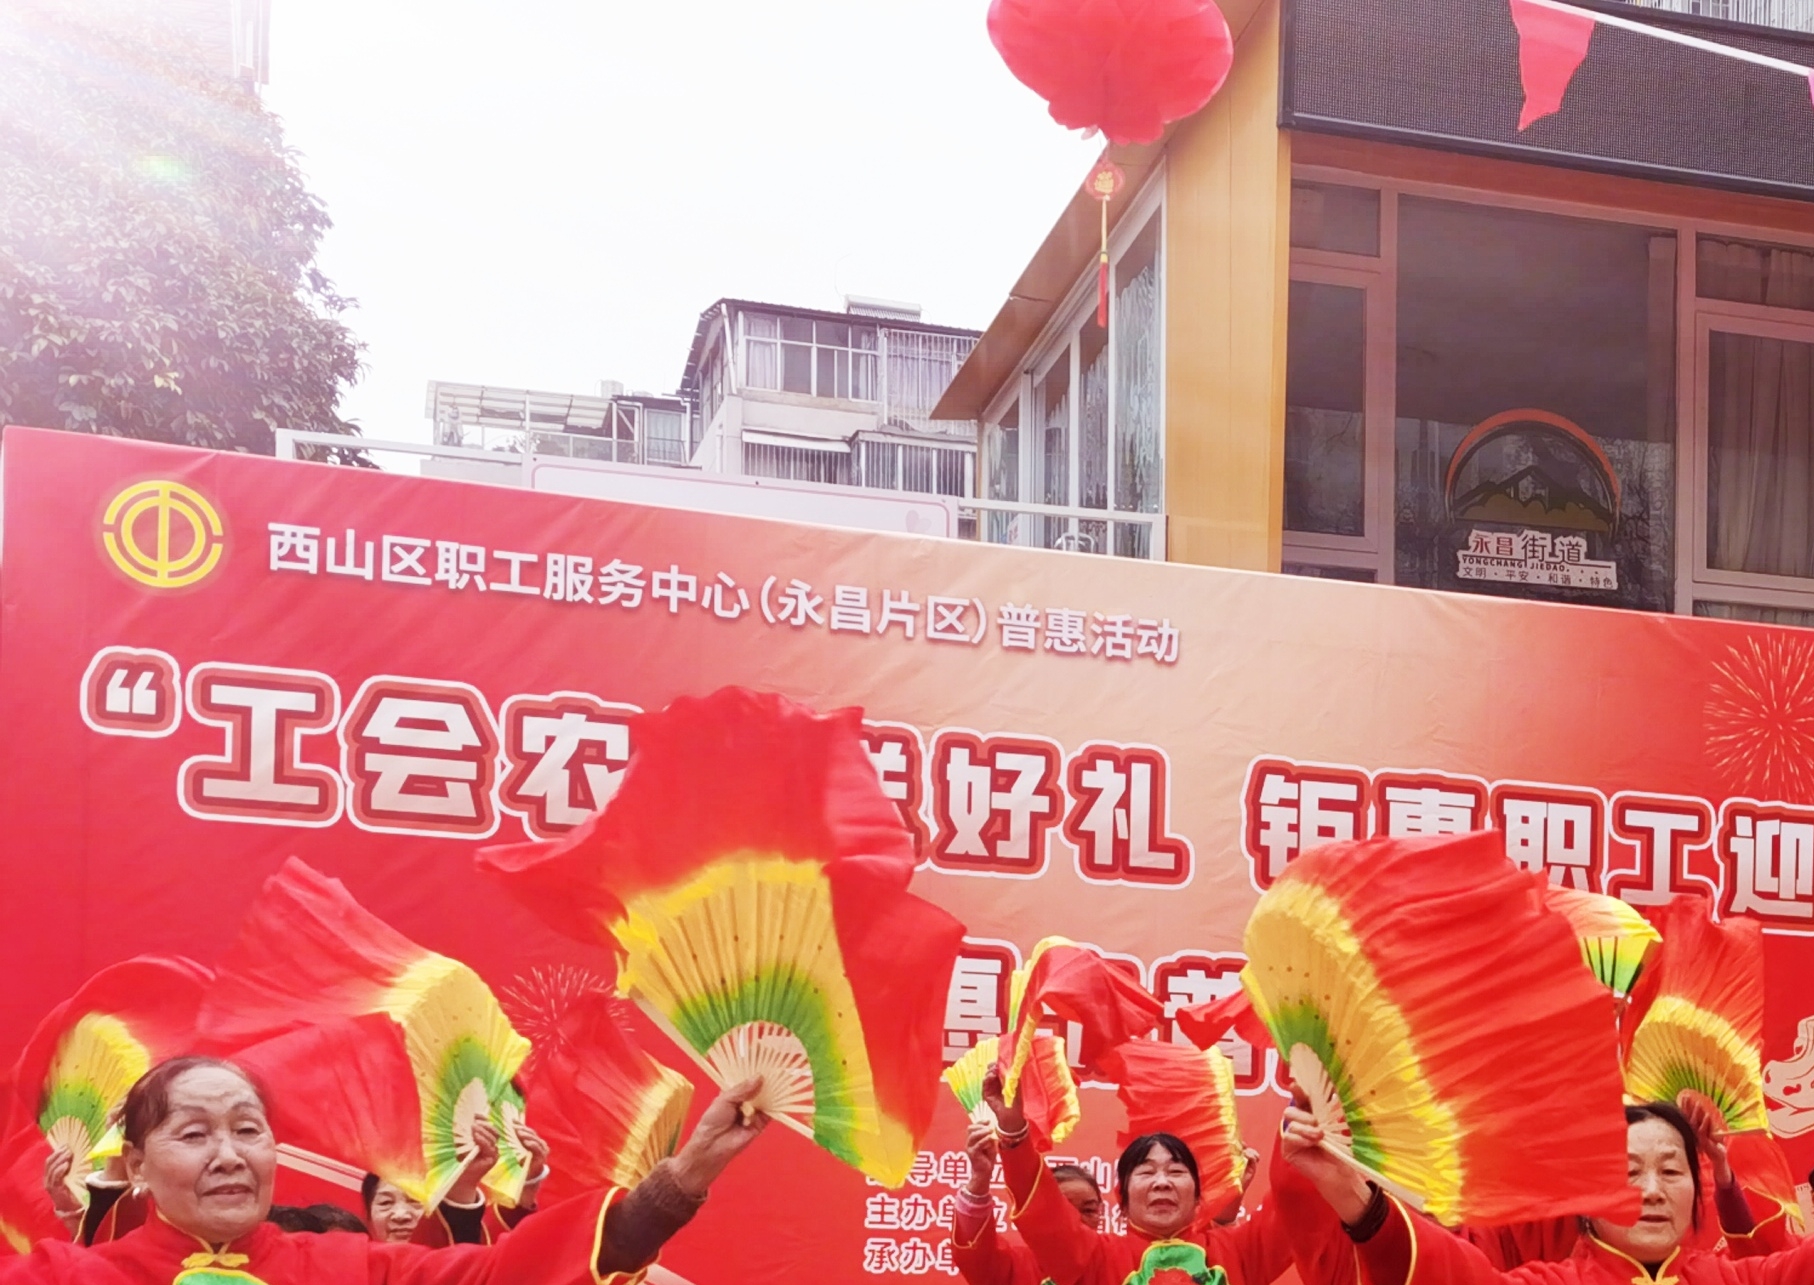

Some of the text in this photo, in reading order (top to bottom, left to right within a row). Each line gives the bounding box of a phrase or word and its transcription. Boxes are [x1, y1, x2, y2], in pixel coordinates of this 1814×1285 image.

[1462, 556, 1523, 569] YONGCHANG
[1472, 533, 1583, 563] 永昌街道
[267, 521, 1180, 664] 西山区职工服务中心（永昌片区）普惠活动
[92, 655, 1183, 880] “工会农好礼
